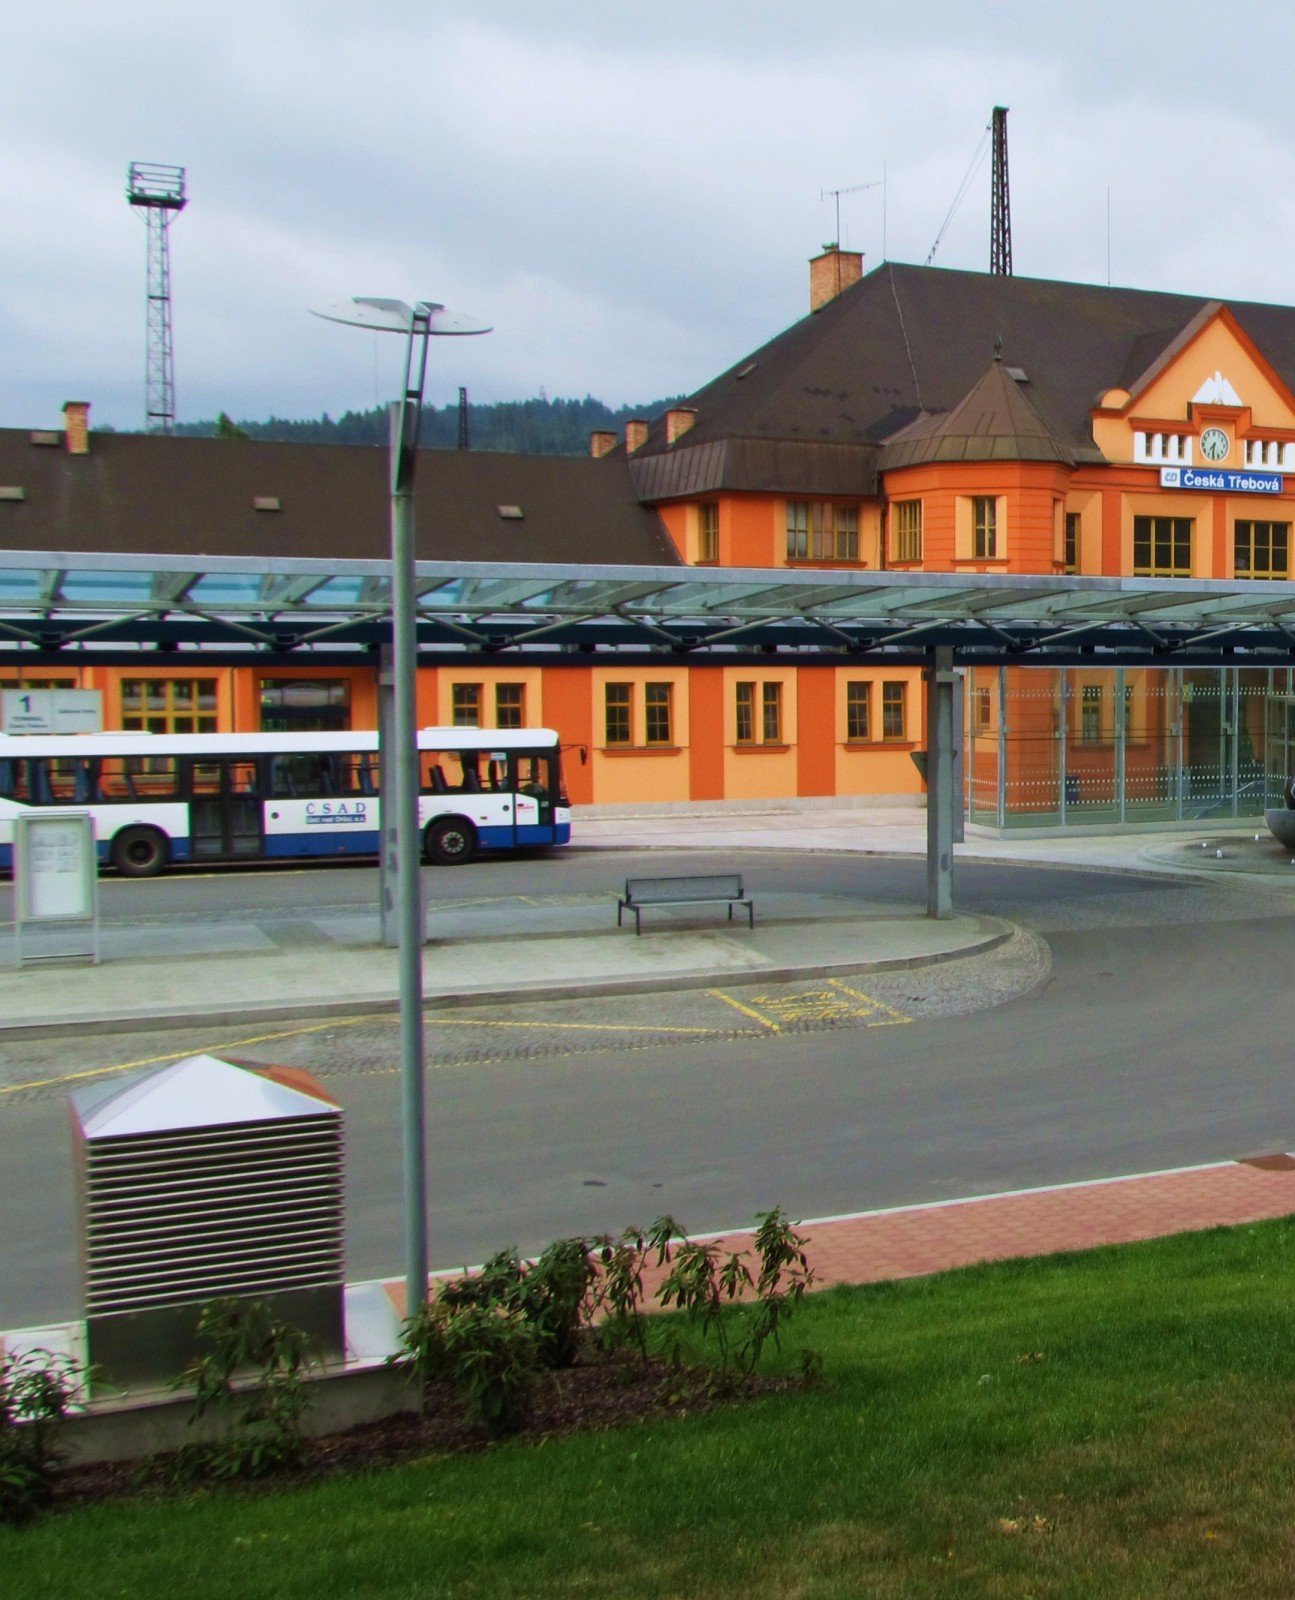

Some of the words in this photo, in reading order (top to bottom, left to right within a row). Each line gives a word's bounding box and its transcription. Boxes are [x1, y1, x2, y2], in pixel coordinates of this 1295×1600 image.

[1183, 469, 1224, 487] Česká
[1228, 475, 1280, 491] Třebová
[19, 694, 31, 713] 1
